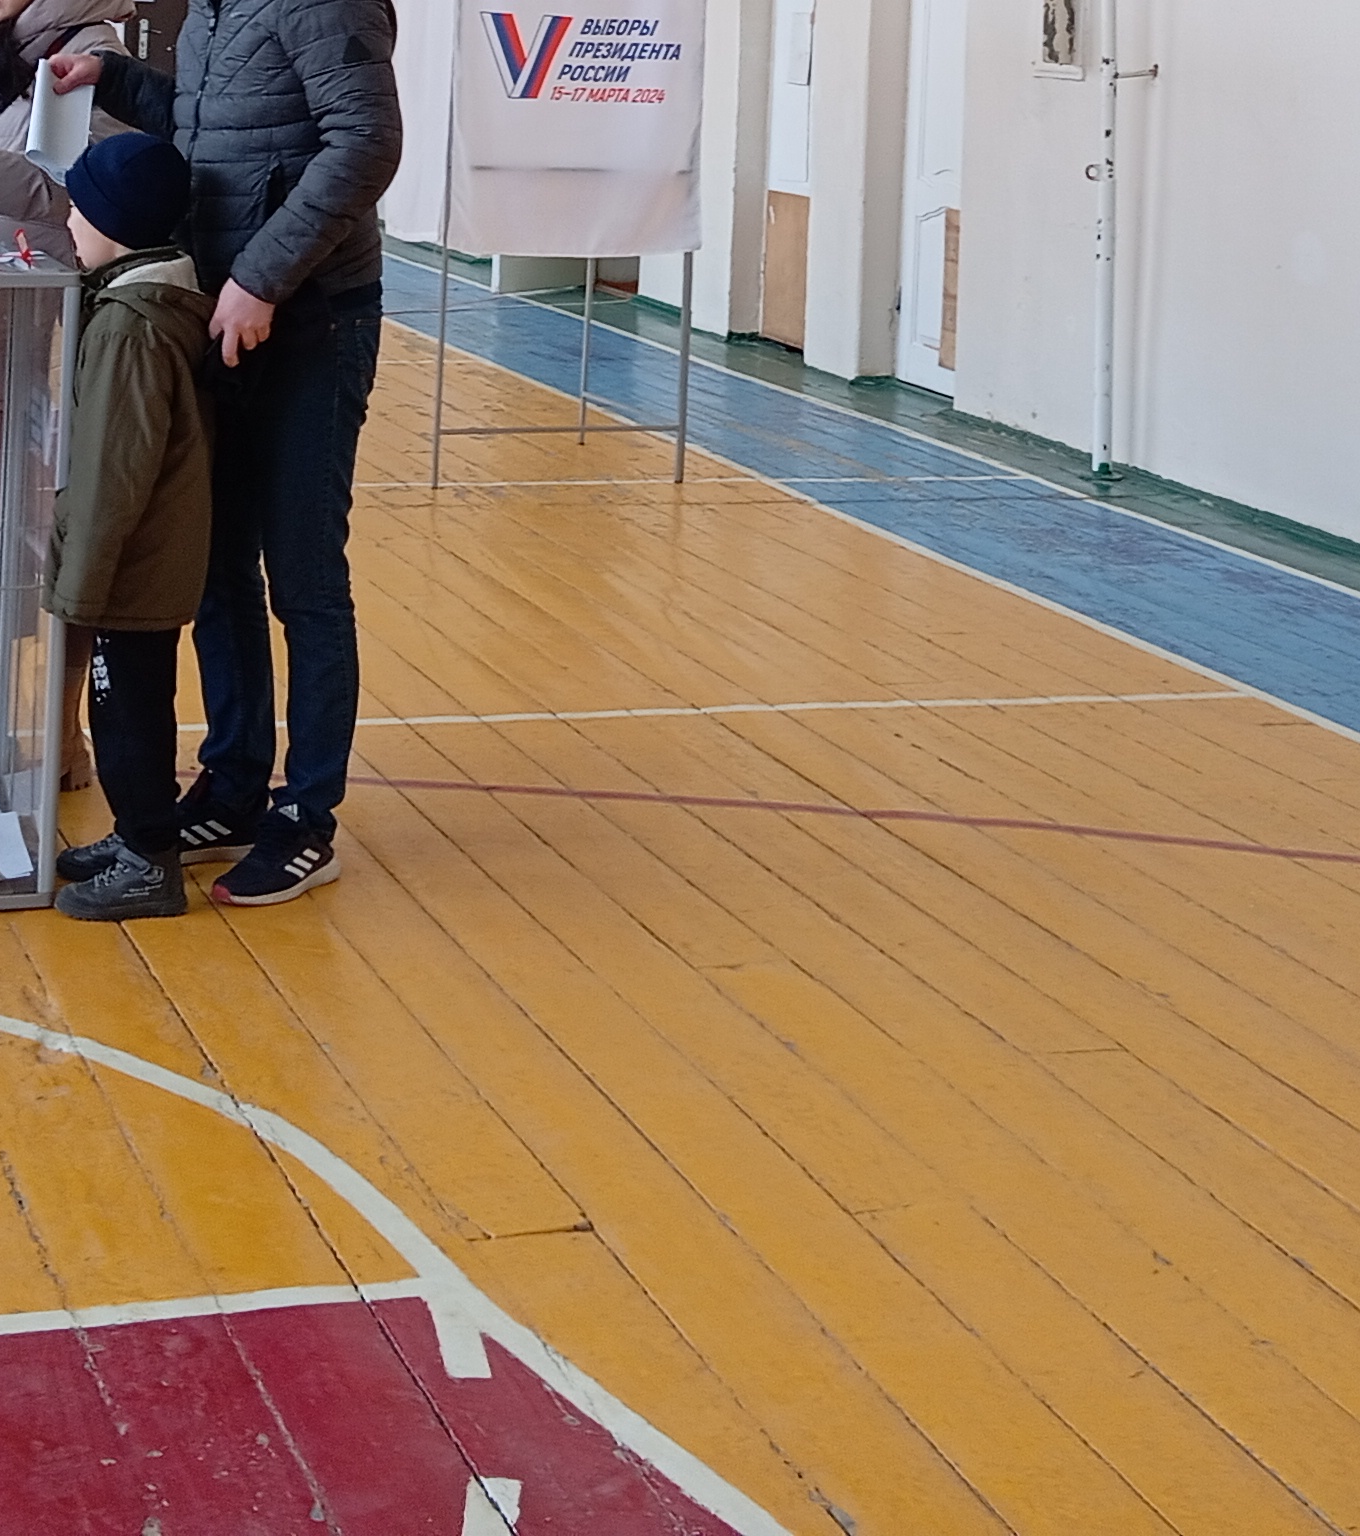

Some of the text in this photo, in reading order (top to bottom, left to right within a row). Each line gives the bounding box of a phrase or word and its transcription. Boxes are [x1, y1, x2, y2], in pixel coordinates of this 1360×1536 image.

[580, 18, 659, 37] ВЫБОРЫ
[568, 41, 682, 62] ПРЕЗИДЕНТА
[557, 64, 631, 83] РОССИИ
[586, 88, 629, 103] МАРТА
[632, 89, 666, 104] 2024
